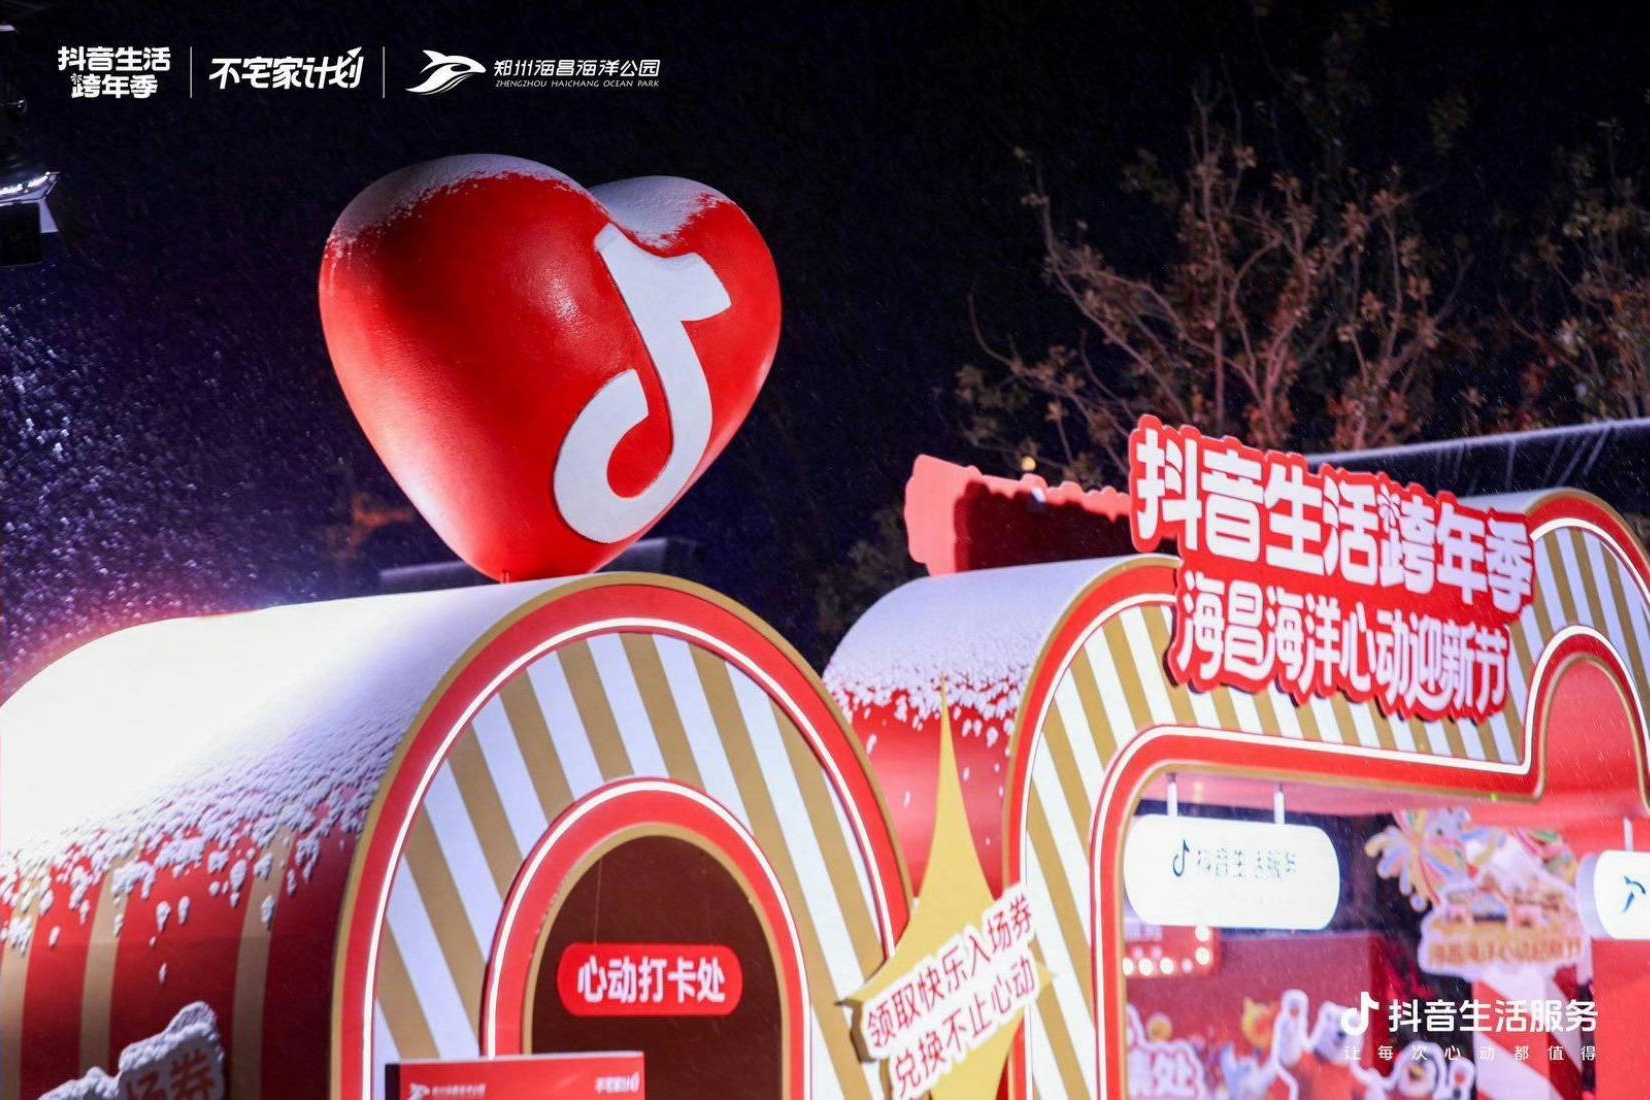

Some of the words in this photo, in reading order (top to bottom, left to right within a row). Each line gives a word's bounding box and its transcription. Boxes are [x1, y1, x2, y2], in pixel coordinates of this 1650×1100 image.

[1136, 428, 1533, 614] 抖音生活跨年季
[1176, 571, 1509, 713] 海昌海洋心动迎新节
[578, 956, 726, 1004] 心动打卡处
[867, 893, 1032, 1048] 领取快乐入场券
[895, 954, 1035, 1098] 兑换不止心动
